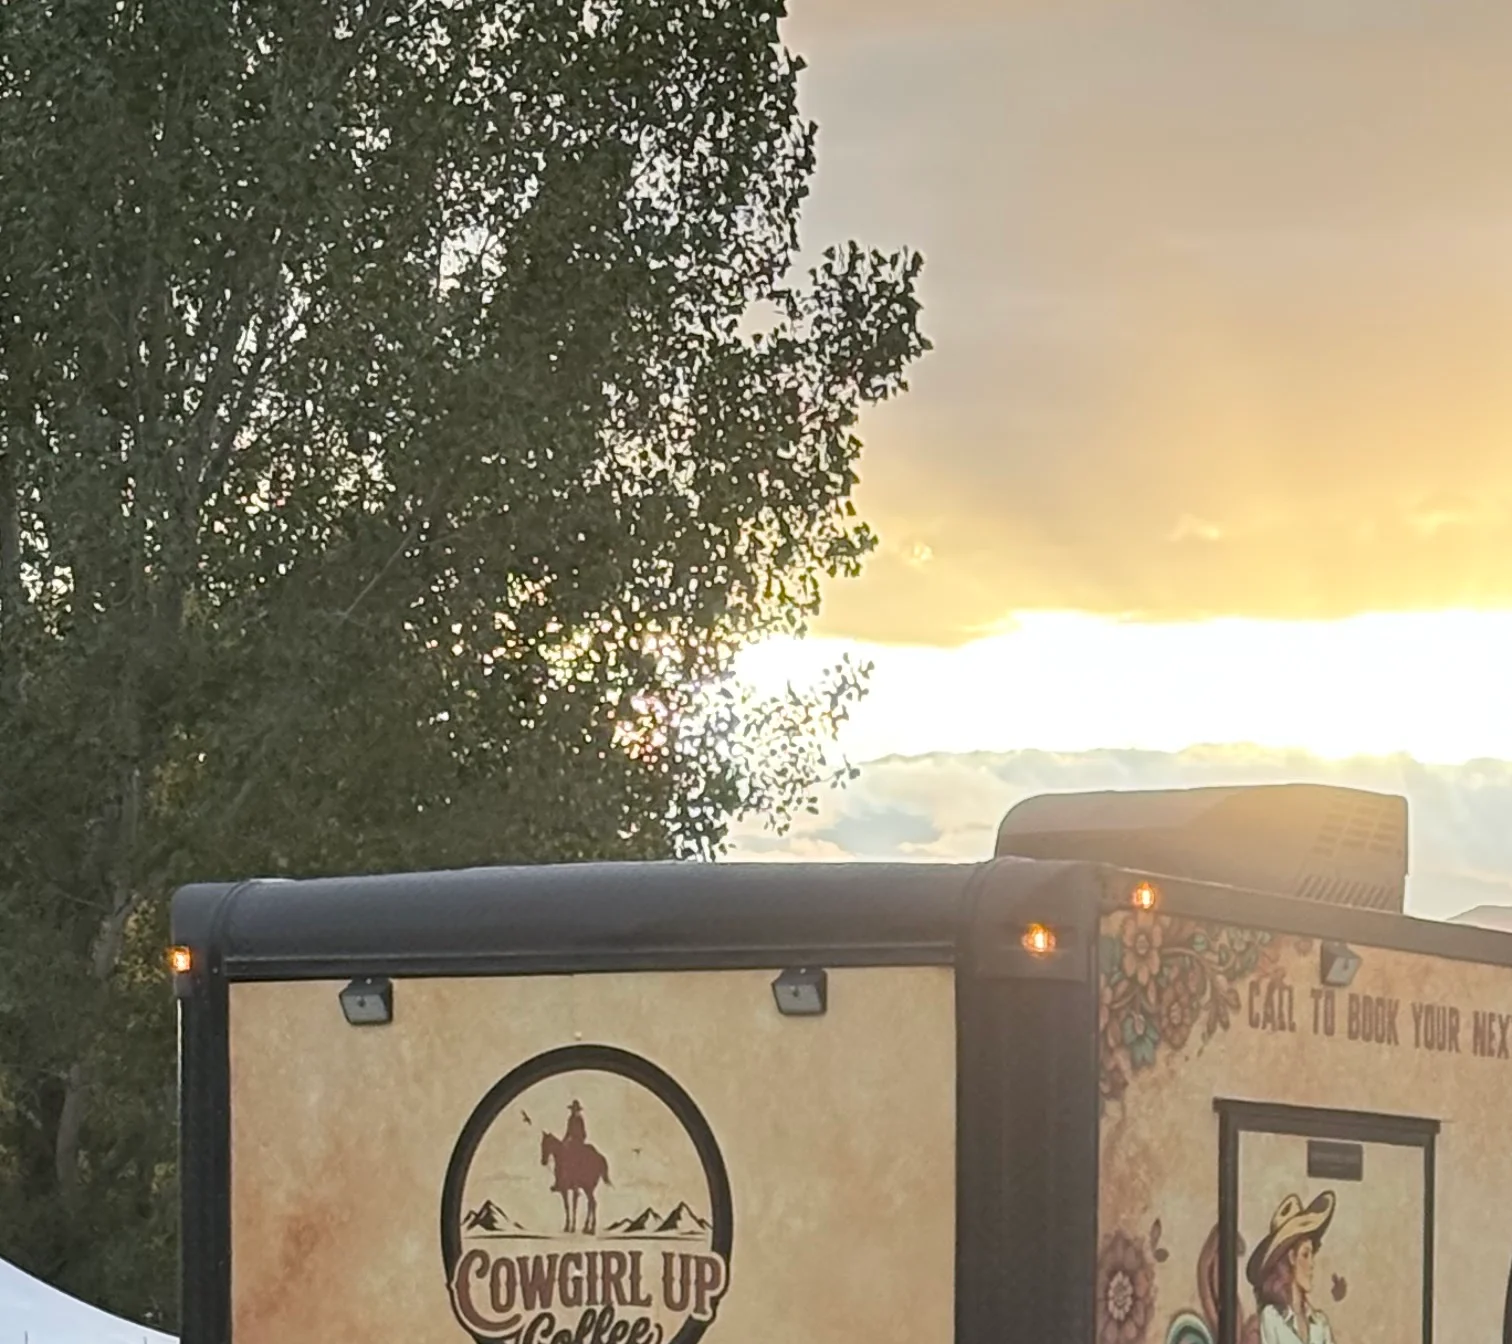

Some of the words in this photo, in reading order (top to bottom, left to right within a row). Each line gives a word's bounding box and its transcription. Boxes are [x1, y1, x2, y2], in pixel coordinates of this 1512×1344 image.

[1249, 980, 1296, 1032] CALL
[1310, 988, 1335, 1037] TO
[1347, 993, 1400, 1046] BOOK
[1411, 1003, 1461, 1053] YOUR
[661, 1250, 722, 1315] UP
